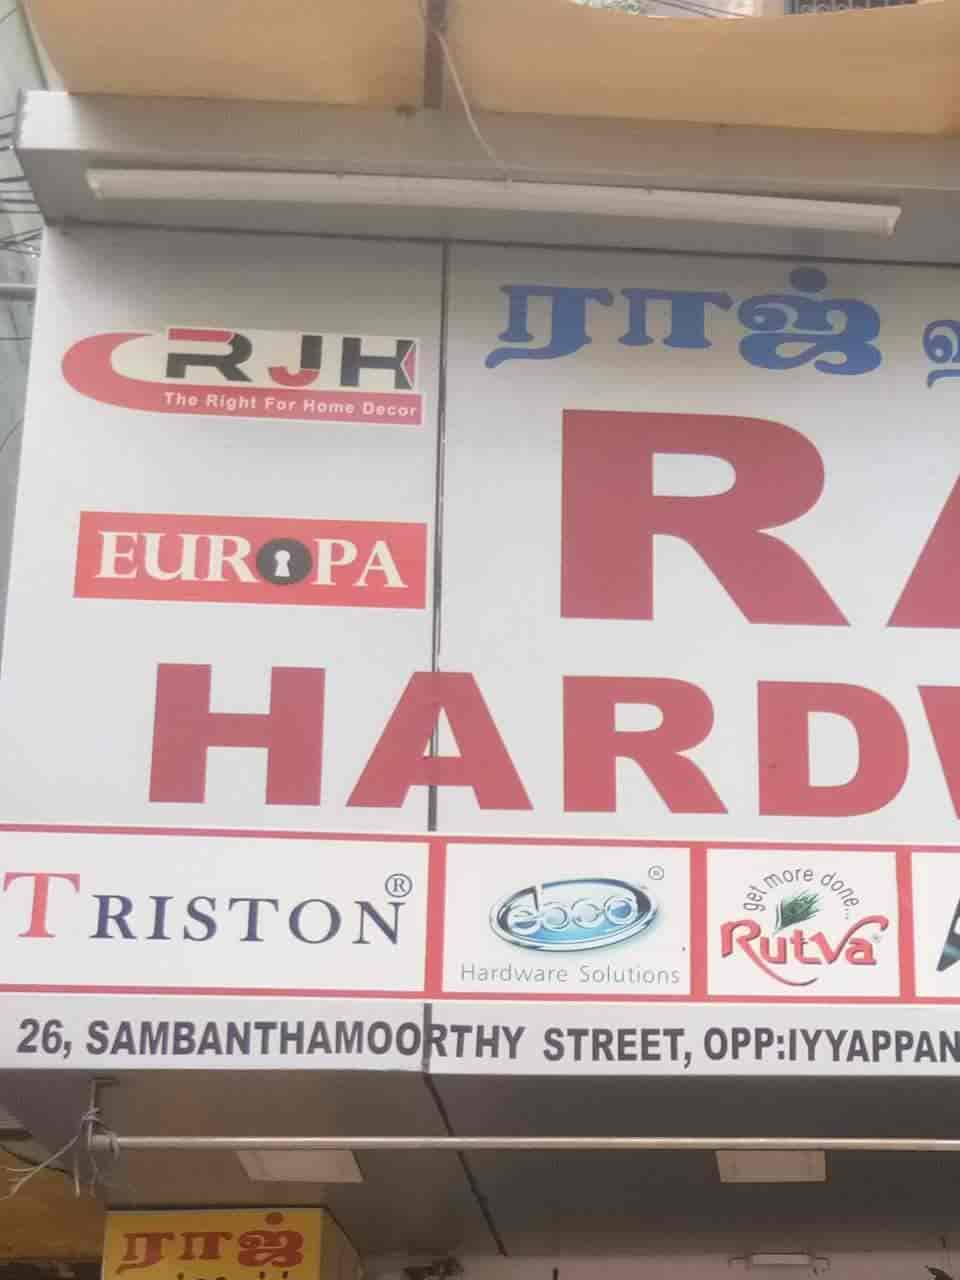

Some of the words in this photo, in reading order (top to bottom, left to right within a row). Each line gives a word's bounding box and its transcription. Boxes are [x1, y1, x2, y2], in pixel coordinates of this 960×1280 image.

[485, 267, 883, 376] ராஜ்
[165, 328, 417, 390] RJH
[164, 391, 198, 408] The
[206, 393, 257, 412] Right
[265, 396, 297, 412] For
[303, 399, 355, 415] Home
[362, 402, 417, 418] Decor
[93, 530, 408, 589] EUROPA
[3, 872, 406, 944] TRISTON
[743, 884, 767, 912] get
[763, 868, 814, 889] more
[461, 963, 568, 984] Hardware
[579, 964, 680, 984] Solutions
[17, 1019, 73, 1058] 26,
[86, 1020, 525, 1060] SAMBANTHAMOORTHY
[543, 1027, 692, 1068] STREET,
[115, 1212, 304, 1275] ராஜ்
